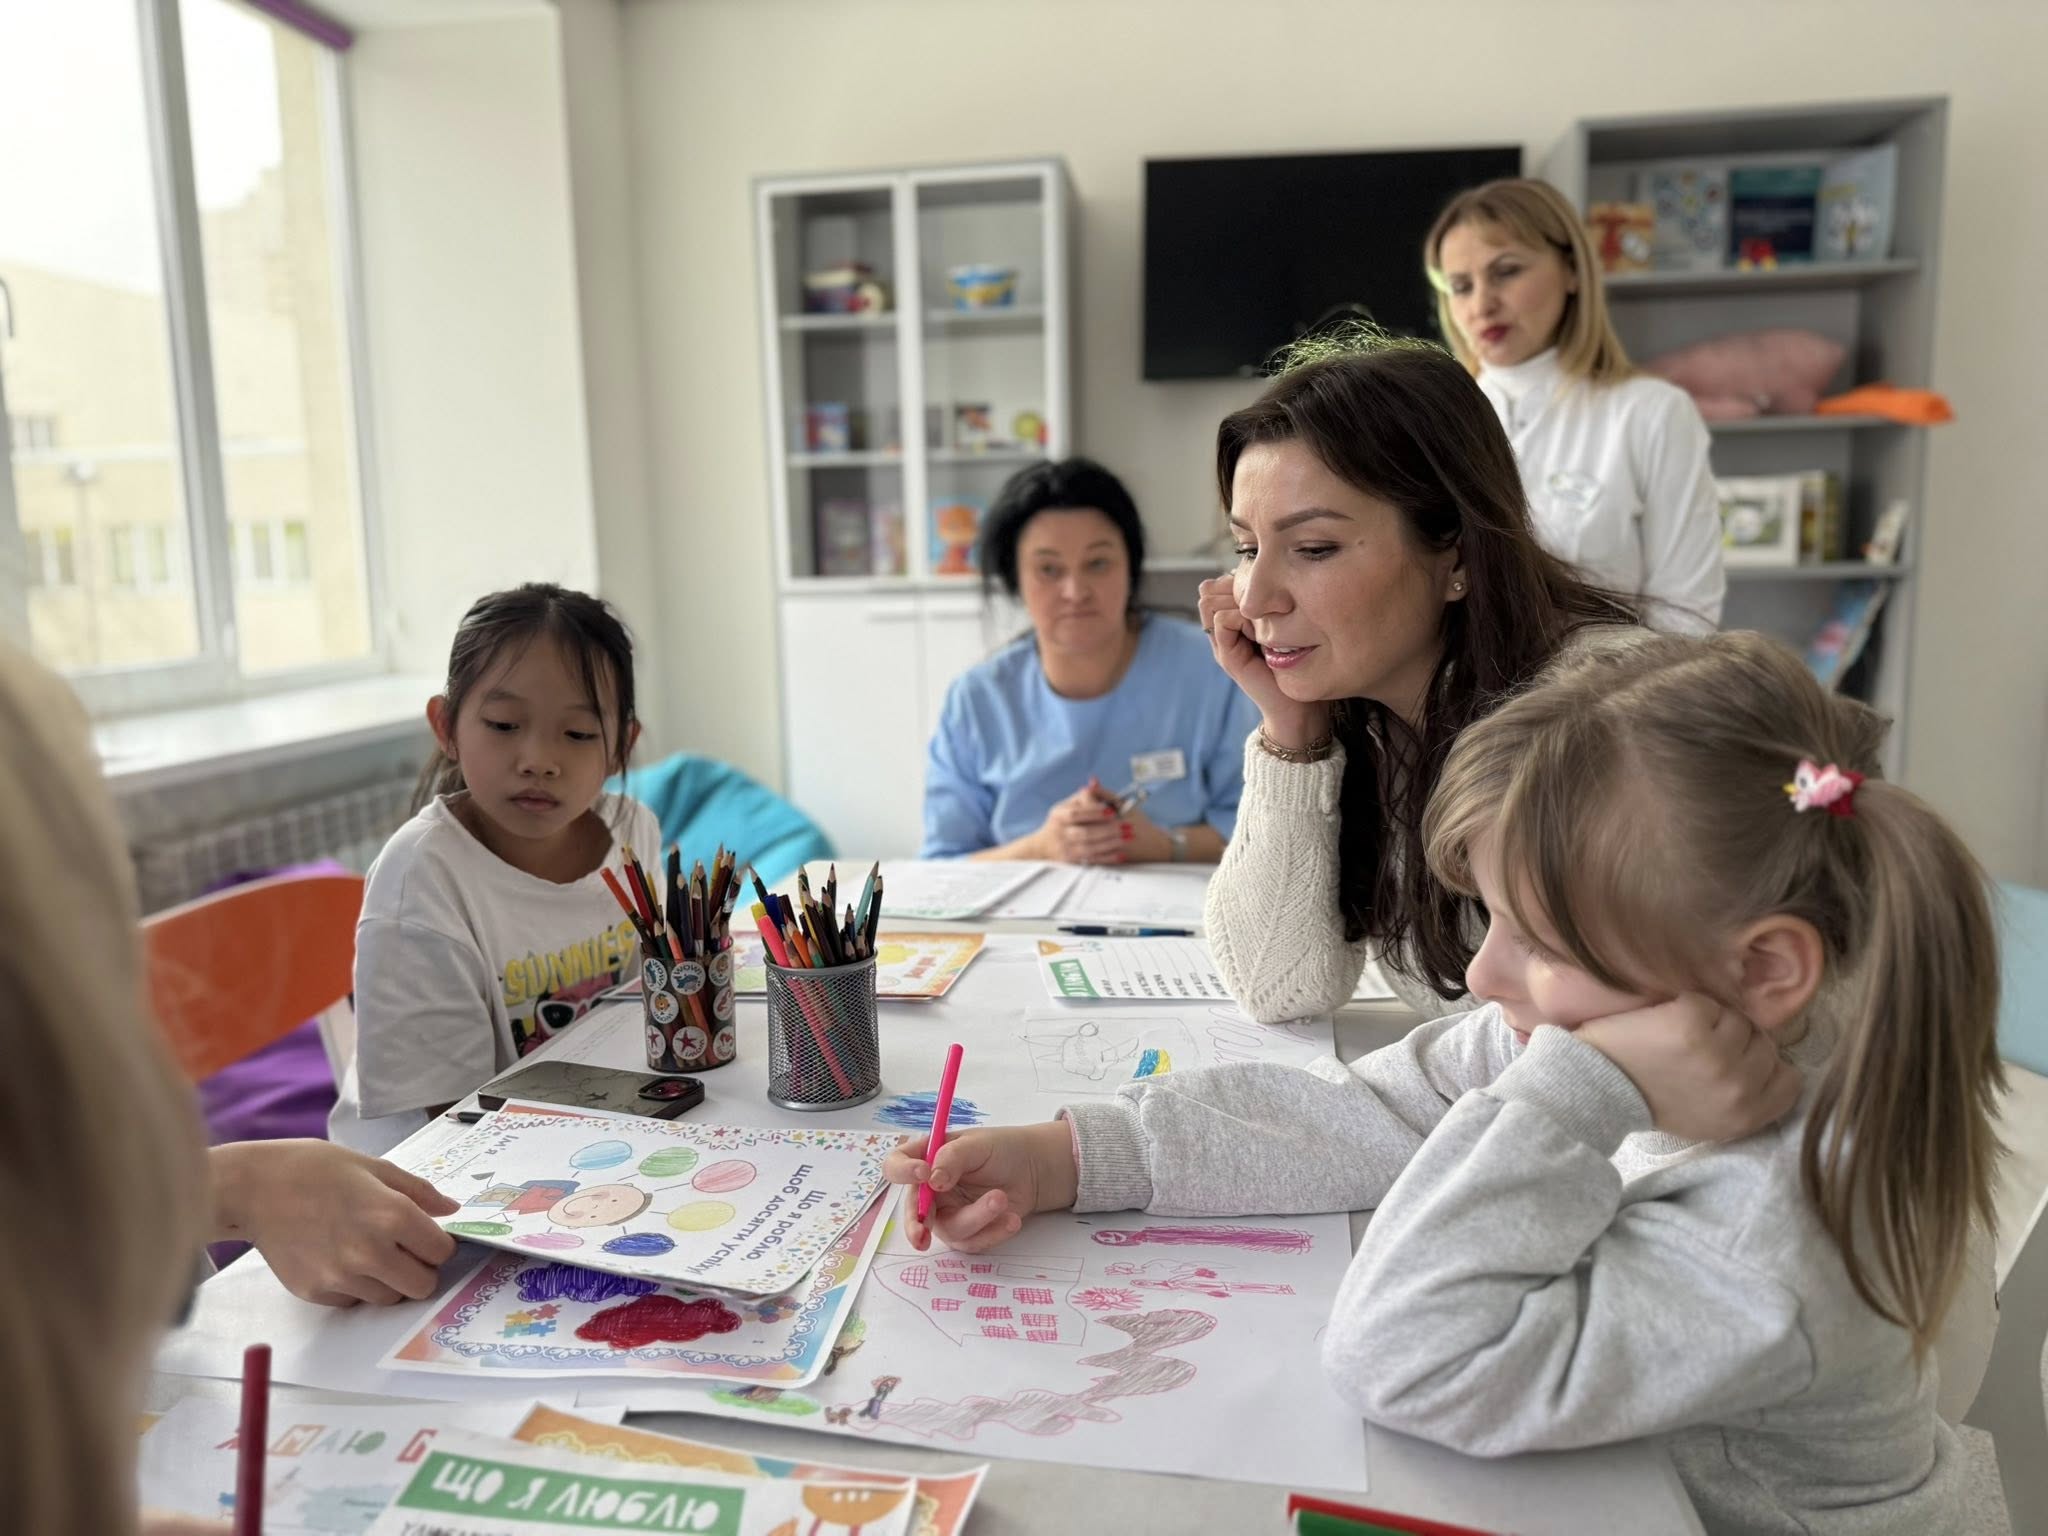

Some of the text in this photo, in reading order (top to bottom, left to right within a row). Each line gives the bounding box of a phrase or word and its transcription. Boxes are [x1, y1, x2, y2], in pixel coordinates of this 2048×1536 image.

[503, 919, 635, 1007] SUNNIES
[674, 965, 703, 976] WOW!
[782, 1163, 814, 1195] щоб
[788, 1211, 803, 1220] я
[797, 1190, 828, 1210] Що
[733, 1194, 786, 1242] досягти
[431, 1459, 721, 1532] ЩО Я ЛЮБЛЮ
